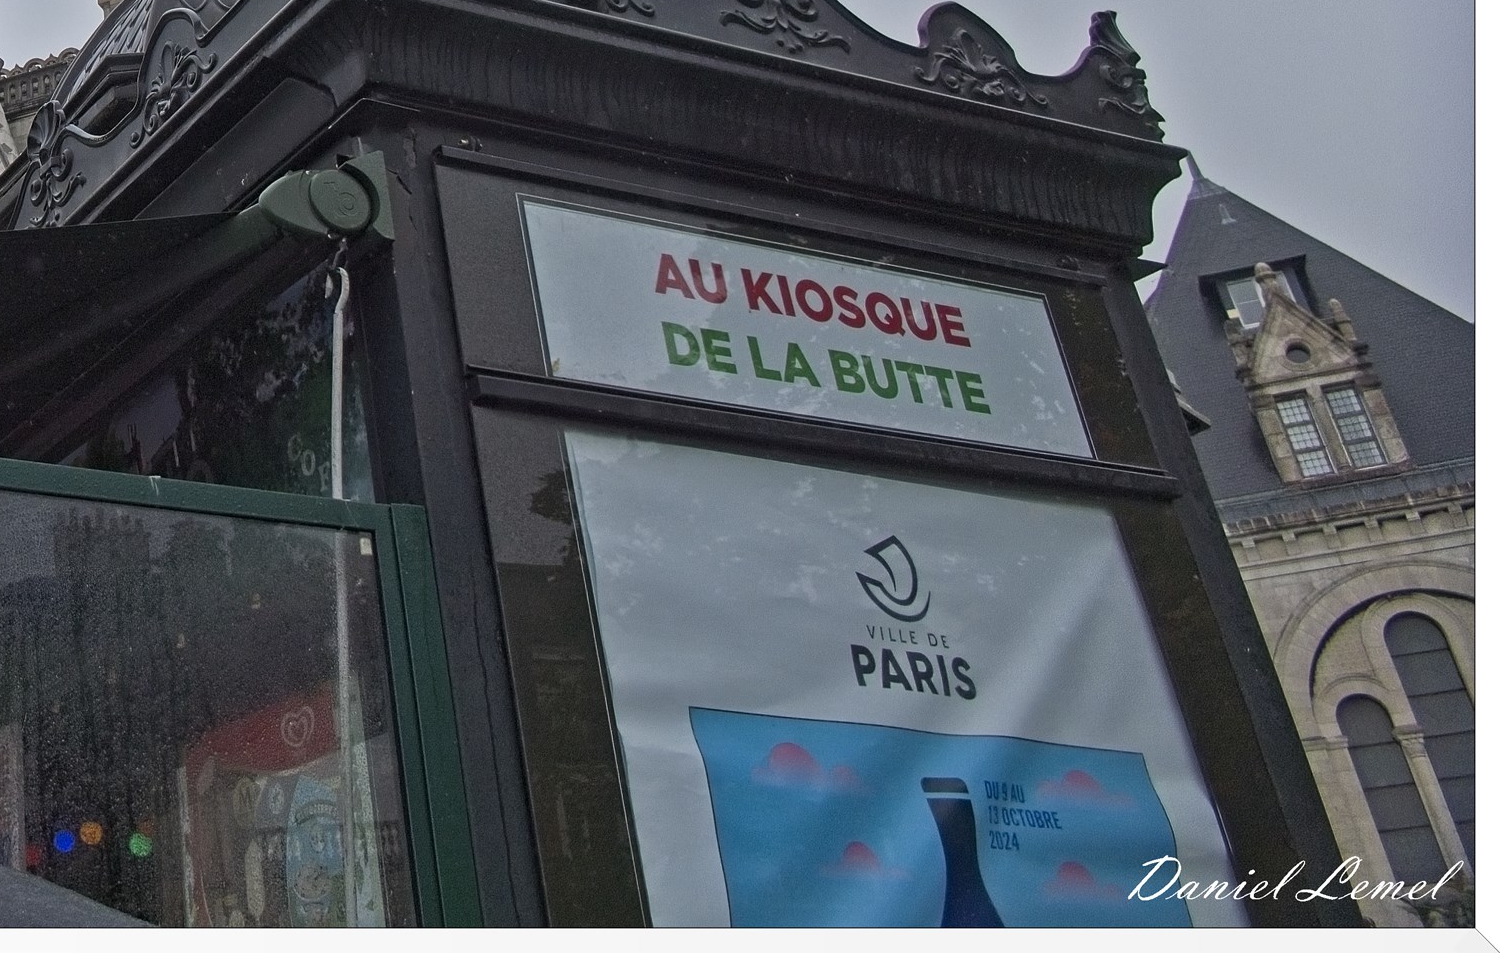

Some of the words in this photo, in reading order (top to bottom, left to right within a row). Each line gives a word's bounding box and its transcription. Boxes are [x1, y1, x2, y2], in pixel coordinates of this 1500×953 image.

[654, 253, 728, 305] AU
[740, 267, 972, 348] KIOSQUE
[661, 321, 738, 375] DE
[746, 335, 822, 389] LA
[827, 349, 992, 415] BUTTE
[865, 624, 918, 645] VILLE
[927, 632, 950, 649] DE
[850, 643, 977, 701] PARIS
[984, 780, 999, 800] DU
[1001, 782, 1008, 801] 9
[1010, 783, 1025, 803] AU
[988, 805, 999, 825] 13
[1001, 807, 1062, 829] OCTOBRE
[989, 830, 1020, 851] 2024
